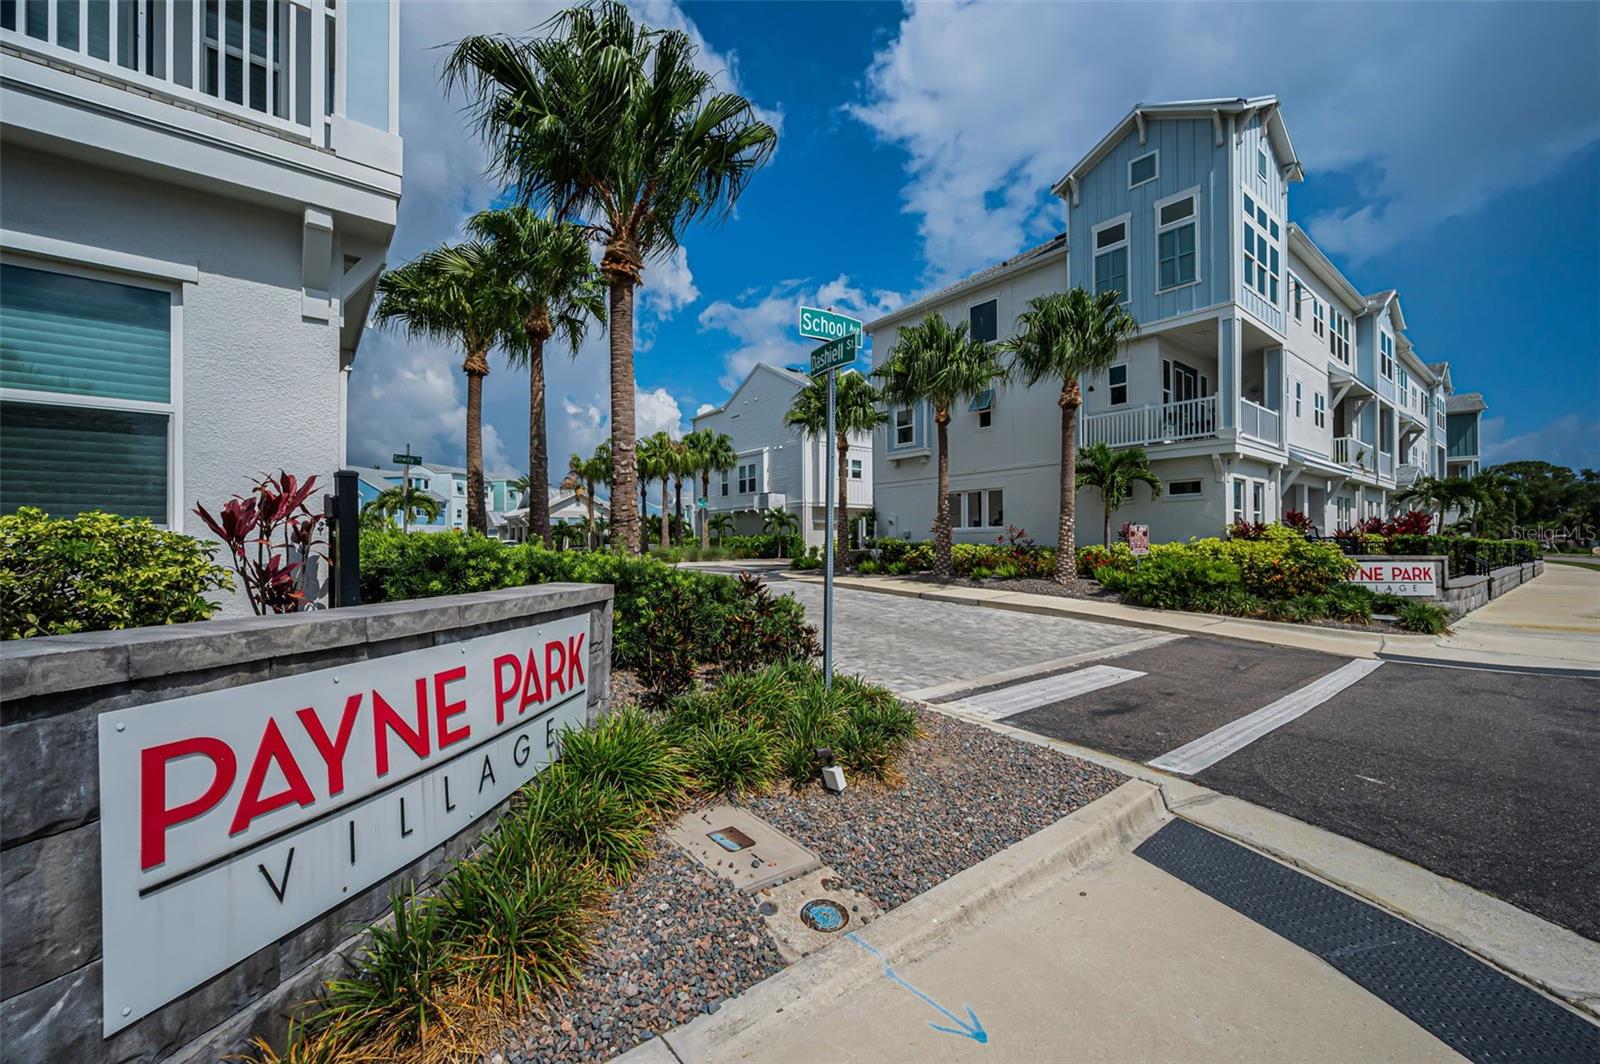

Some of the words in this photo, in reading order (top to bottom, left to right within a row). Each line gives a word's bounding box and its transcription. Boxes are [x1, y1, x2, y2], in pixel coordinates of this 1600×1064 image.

[802, 313, 845, 336] School
[849, 323, 860, 335] Ave
[811, 343, 843, 371] Dashiell
[1391, 566, 1433, 581] PARK
[1375, 584, 1418, 592] LAGE
[140, 666, 471, 872] PAYNE
[493, 632, 585, 725] PARK
[258, 717, 555, 904] VILLAGE
